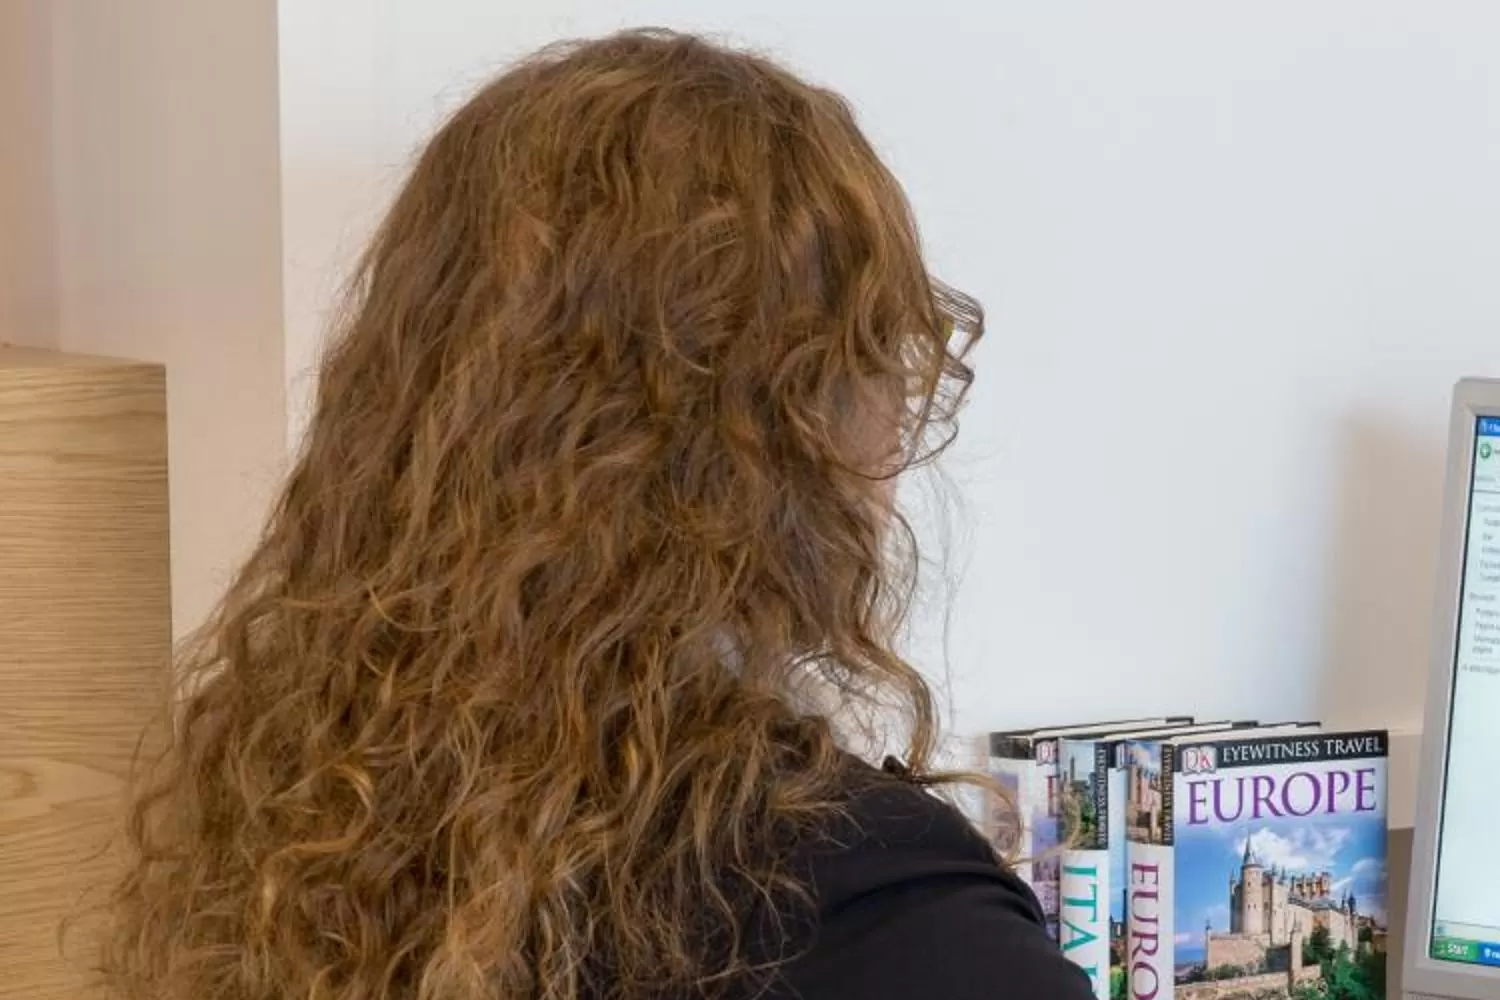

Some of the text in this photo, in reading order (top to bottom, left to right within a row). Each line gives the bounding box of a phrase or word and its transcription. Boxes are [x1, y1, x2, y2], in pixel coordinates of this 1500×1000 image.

[1223, 736, 1383, 763] EYEWITNESS TRAVEL
[1187, 767, 1377, 826] EUROPE
[1062, 864, 1098, 980] ITA
